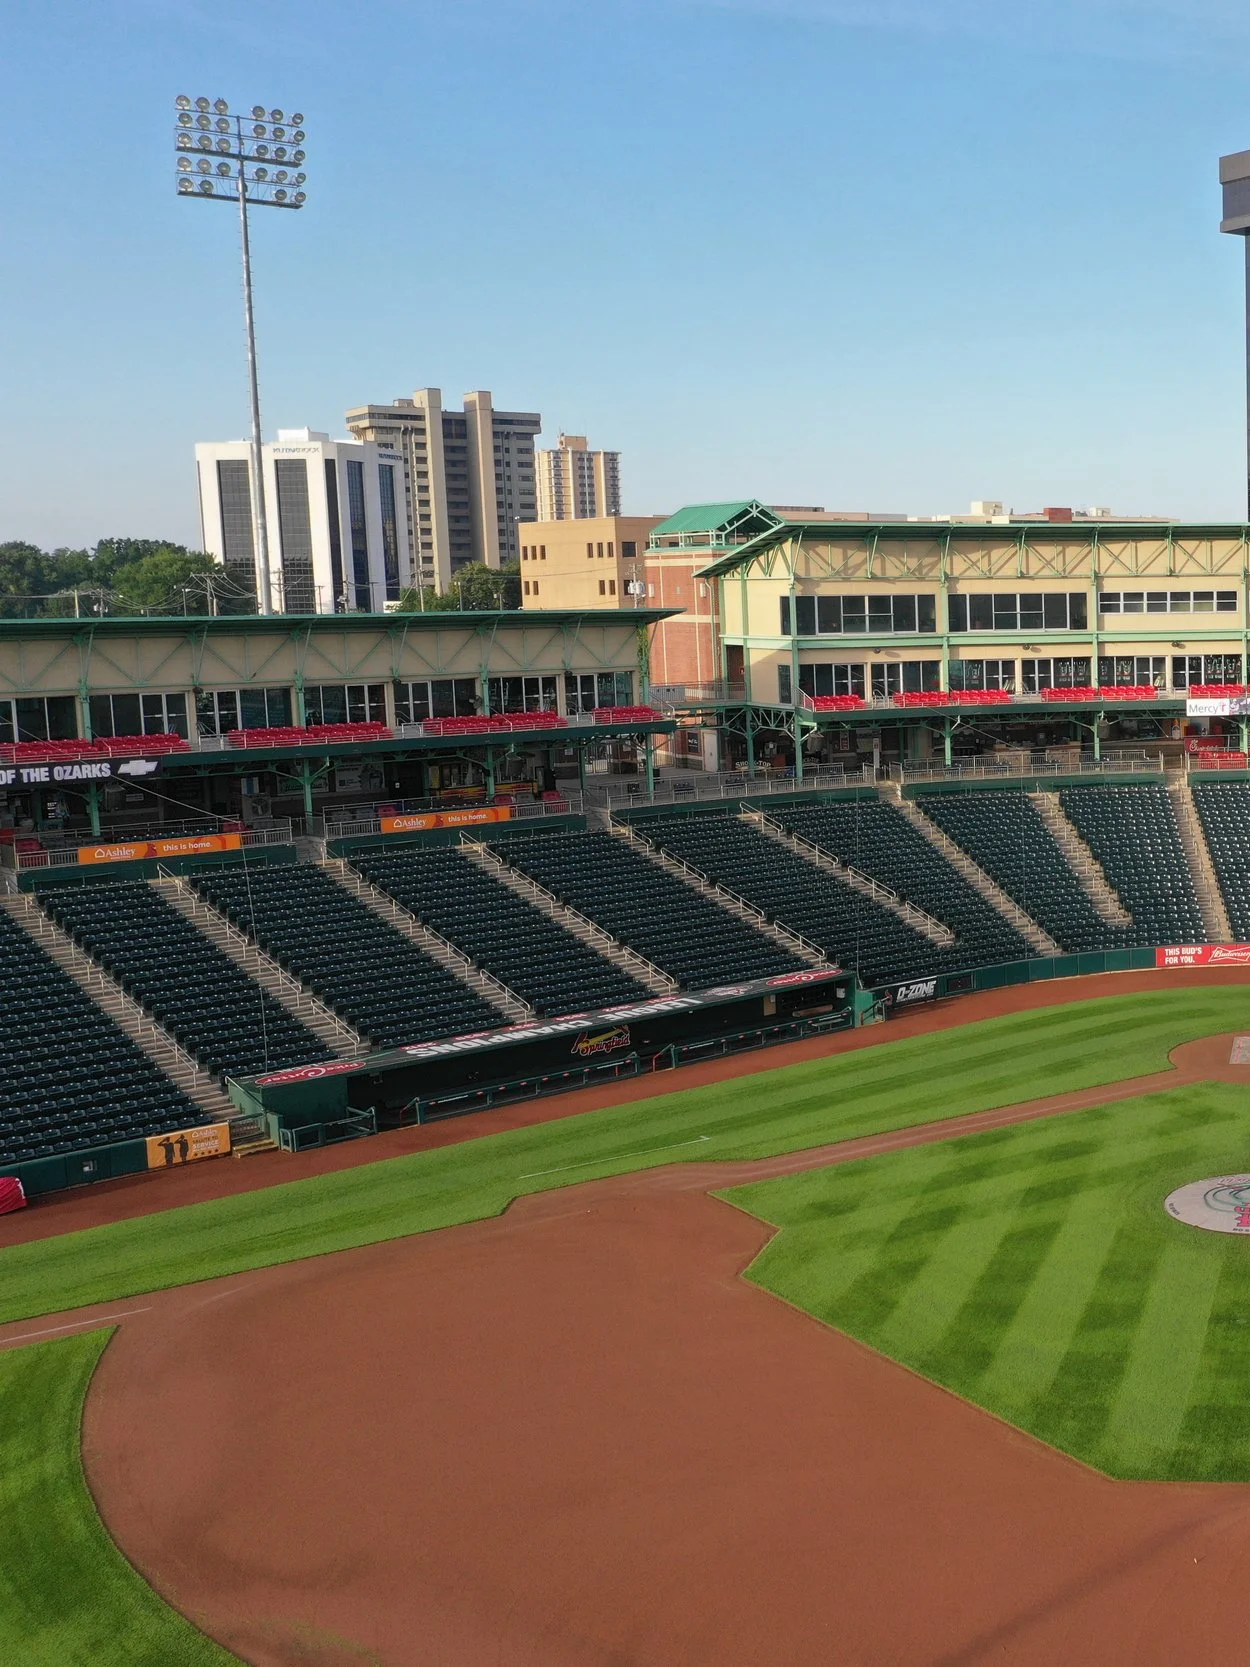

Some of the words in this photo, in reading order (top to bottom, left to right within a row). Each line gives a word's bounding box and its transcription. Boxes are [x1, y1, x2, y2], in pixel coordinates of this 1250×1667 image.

[1188, 703, 1218, 715] Mercy
[20, 767, 50, 783] THE
[54, 763, 111, 781] OZARKS
[402, 818, 427, 828] Ashley
[105, 847, 136, 858] Ashley
[163, 844, 178, 852] this
[189, 842, 213, 850] home.
[1165, 948, 1180, 956] THIS
[1181, 947, 1202, 955] BUD'S
[1165, 956, 1178, 965] FOR
[1180, 956, 1195, 964] YOU.
[598, 997, 703, 1021] LEAGUE
[406, 1020, 593, 1057] CHAMPIONS
[580, 1033, 631, 1057] Springfield
[192, 1139, 219, 1149] SERVICE
